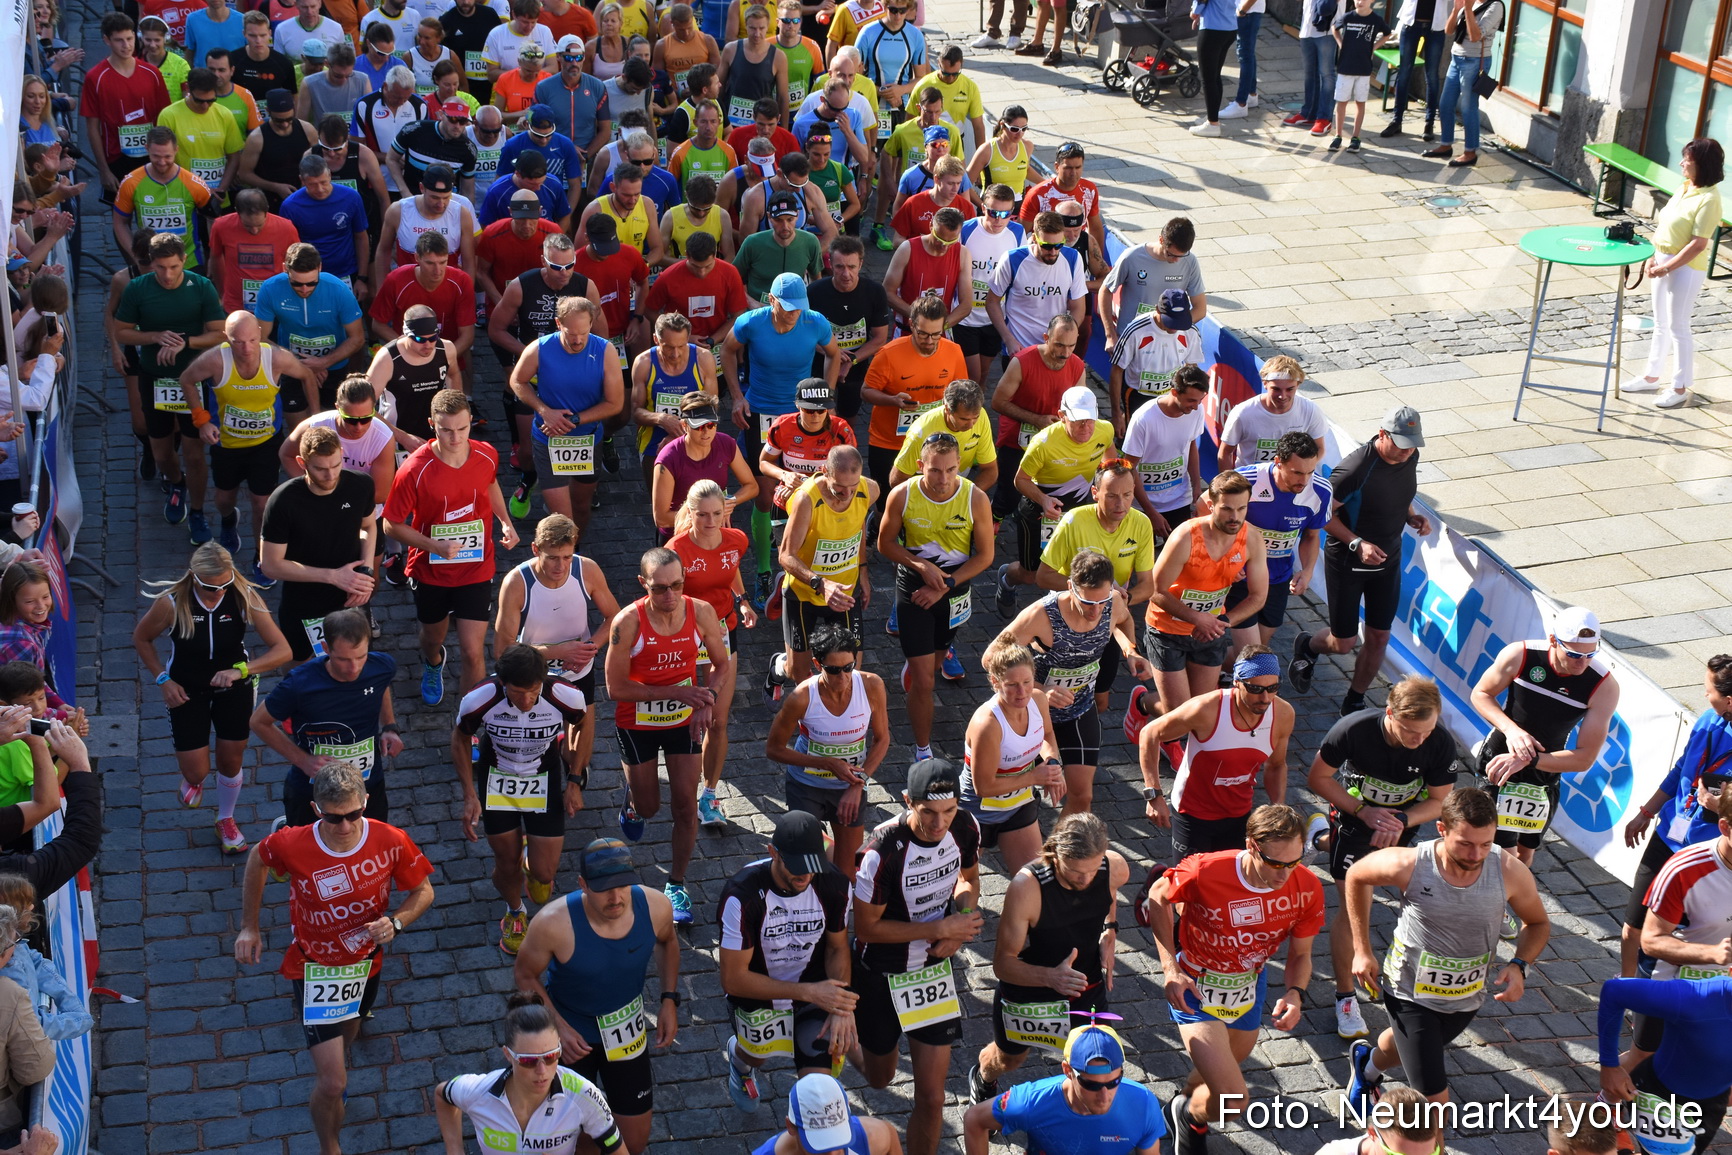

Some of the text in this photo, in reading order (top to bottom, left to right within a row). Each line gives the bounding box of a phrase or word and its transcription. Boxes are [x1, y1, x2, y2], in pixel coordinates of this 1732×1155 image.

[192, 159, 225, 169] BOCK
[143, 206, 181, 216] BOCK
[147, 216, 182, 228] 2729
[801, 387, 830, 400] OAKLEY
[227, 405, 273, 419] BOCK
[230, 416, 267, 429] 1063
[227, 427, 267, 436] CHRISTIAN
[552, 436, 591, 447] BOCK
[554, 448, 589, 462] 1078
[557, 463, 588, 471] CARSTEN
[1140, 457, 1182, 473] BOCK
[1143, 469, 1180, 484] 2249
[1150, 482, 1172, 491] KEVIN
[435, 522, 480, 536] BOCK
[820, 535, 859, 550] BOCK
[821, 545, 856, 564] 1012
[820, 561, 851, 572] THOMAS
[1186, 588, 1228, 601] BOCK
[657, 650, 683, 664] DJK
[647, 713, 684, 722] JÜRGEN
[485, 724, 561, 738] POSITIV
[811, 725, 830, 737] team
[319, 740, 370, 758] BOCK
[812, 740, 862, 756] BOCK
[496, 777, 541, 796] 1372
[1505, 797, 1545, 818] 1127
[1505, 818, 1539, 829] FLORIAN
[1342, 854, 1355, 870] 5
[315, 867, 345, 880] raumbox
[905, 857, 960, 887] POSITIV
[1230, 899, 1261, 910] raumbox
[764, 918, 824, 938] POSITIV
[1427, 954, 1485, 972] BOCK
[310, 964, 367, 979] BOCK
[894, 962, 946, 989] BOCK
[1426, 968, 1480, 986] 1340
[1203, 972, 1258, 989] BOCK
[312, 980, 362, 1004] 2260
[899, 980, 950, 1009] 1382
[1204, 987, 1250, 1005] 1172
[1421, 982, 1479, 997] ALEXANDER
[322, 1005, 350, 1018] JOSEF
[1006, 1003, 1061, 1018] BOCK
[1215, 1007, 1240, 1018] TOMS
[740, 1018, 788, 1044] 1361
[1010, 1018, 1063, 1035] 1047
[1020, 1034, 1058, 1046] ROMAN
[809, 1109, 844, 1127] ATSV
[488, 1132, 511, 1148] CIS
